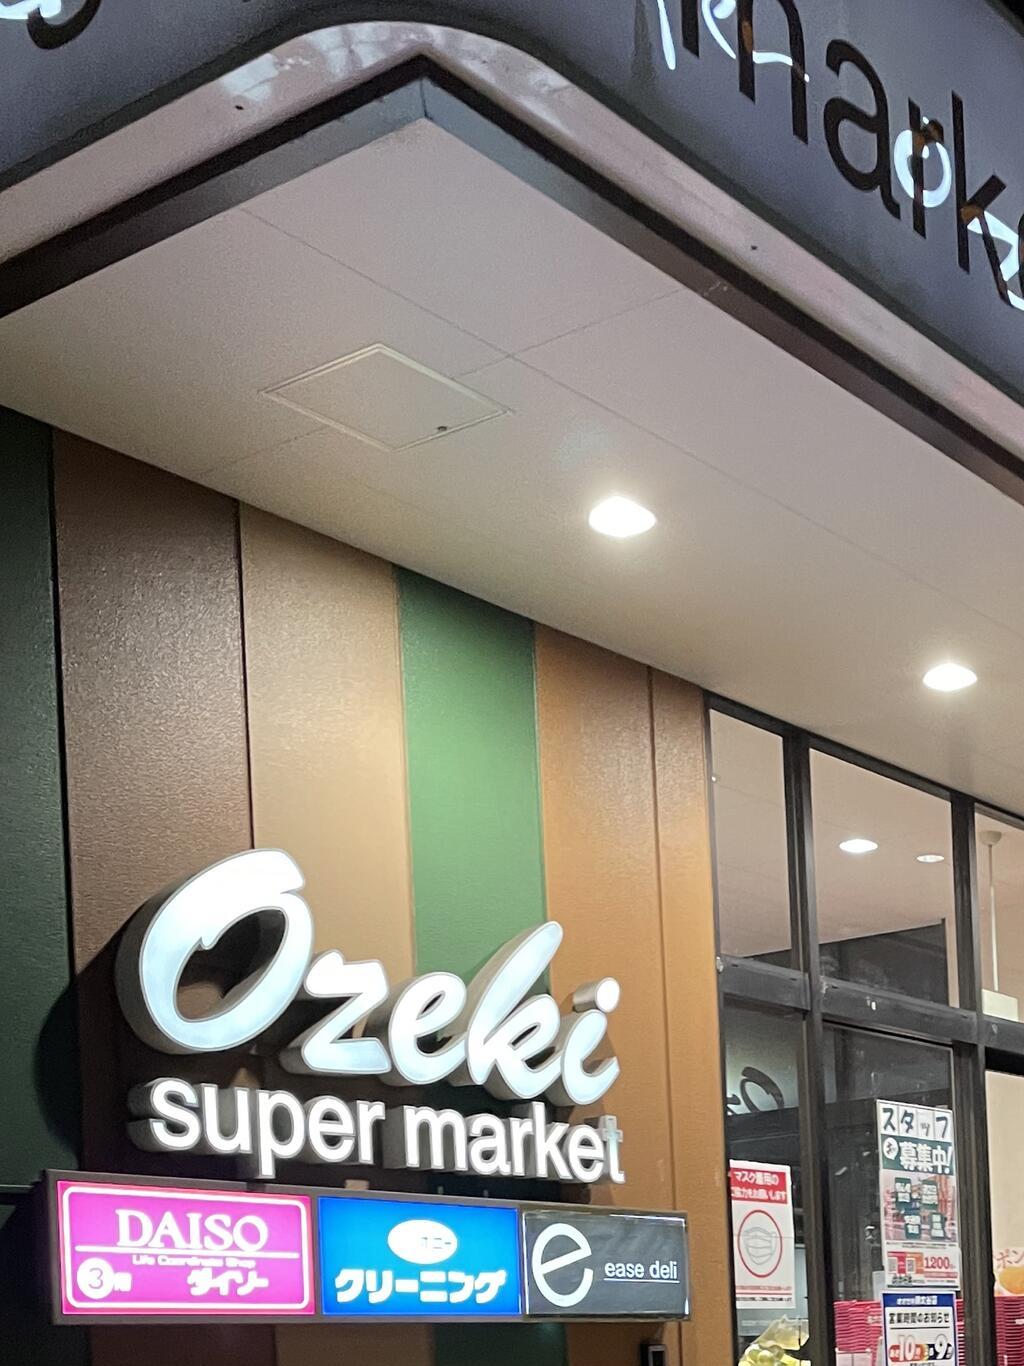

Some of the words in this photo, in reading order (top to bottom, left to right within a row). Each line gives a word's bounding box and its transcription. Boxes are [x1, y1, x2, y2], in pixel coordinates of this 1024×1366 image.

[139, 848, 620, 1105] Ozeki
[150, 1077, 386, 1179] super
[403, 1101, 625, 1184] market
[882, 1107, 948, 1139] スタッフ
[115, 1208, 269, 1252] DAISO
[335, 1267, 507, 1305] クリーニング
[603, 1262, 644, 1280] ease
[649, 1260, 677, 1281] deli
